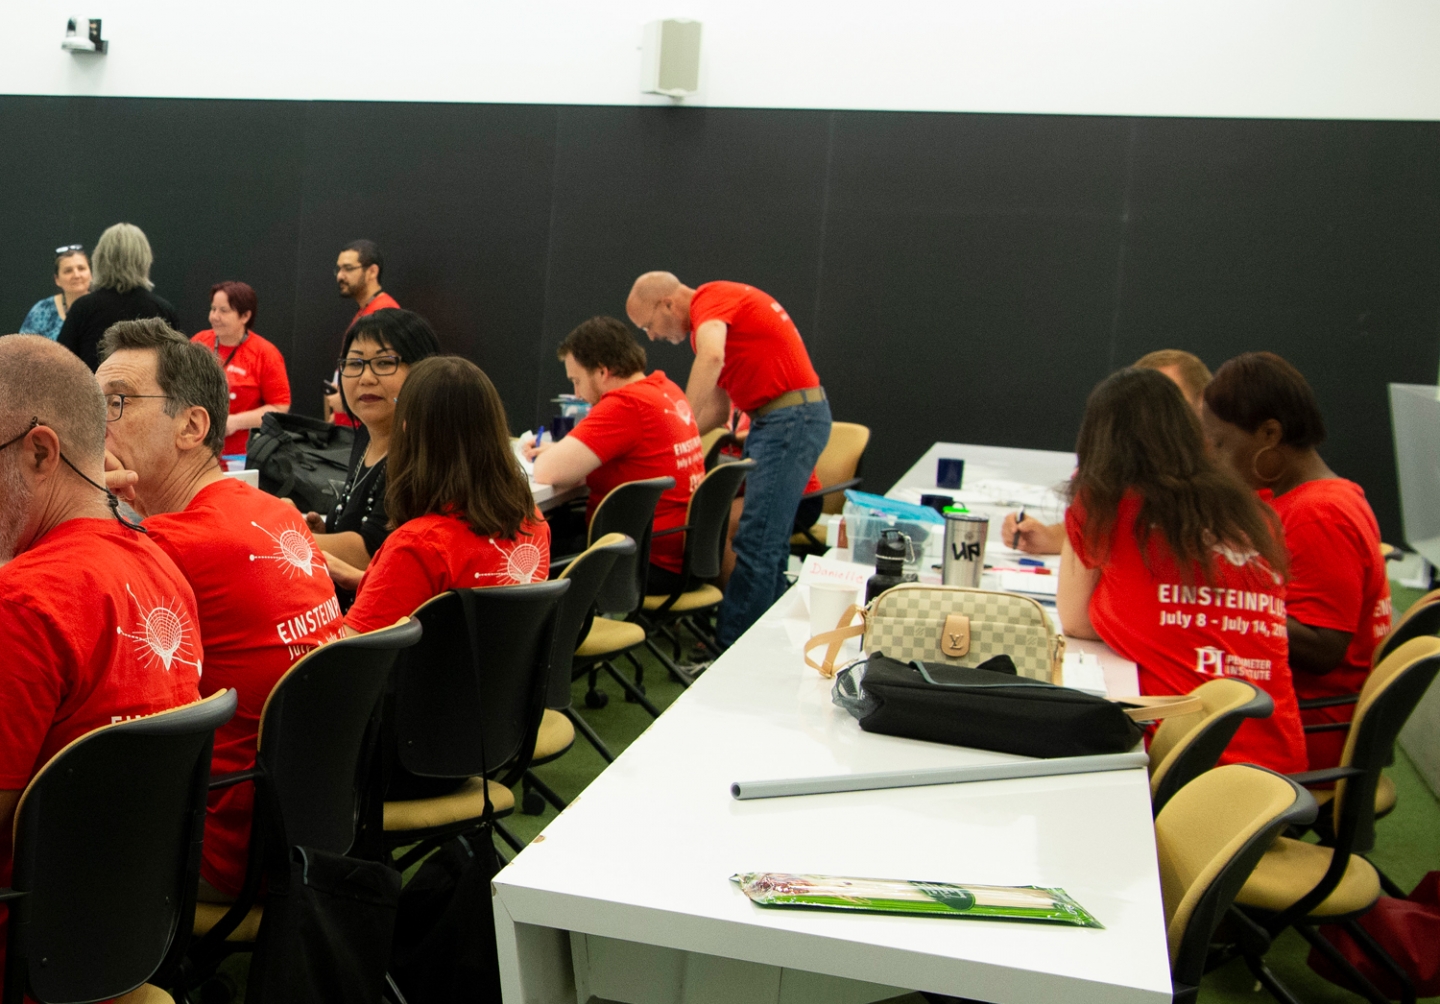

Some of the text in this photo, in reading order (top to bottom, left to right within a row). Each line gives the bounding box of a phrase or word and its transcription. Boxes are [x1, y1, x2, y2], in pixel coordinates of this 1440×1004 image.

[1160, 611, 1191, 629] July
[1196, 613, 1207, 627] 8
[1221, 615, 1249, 635] July
